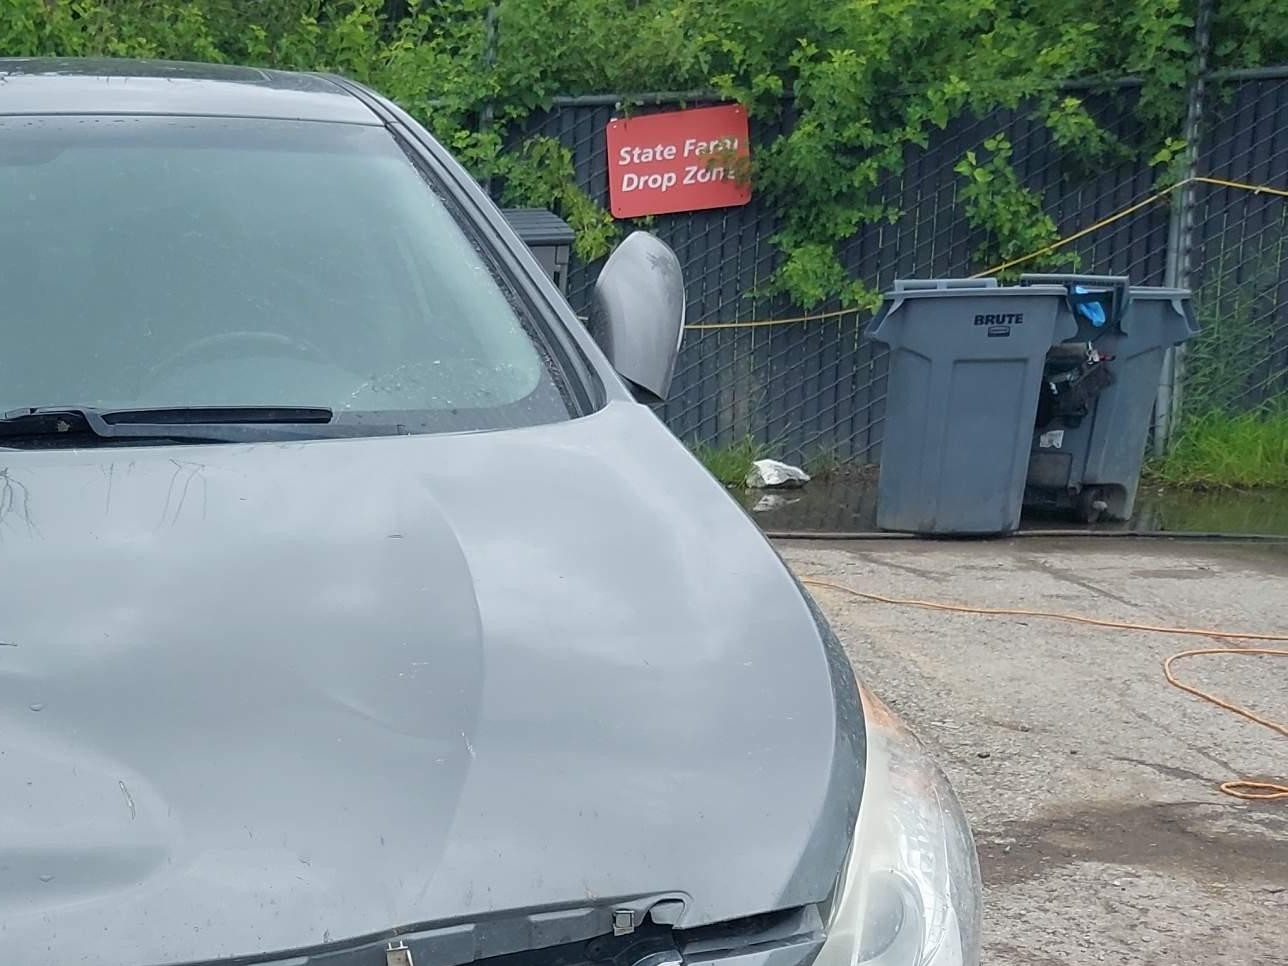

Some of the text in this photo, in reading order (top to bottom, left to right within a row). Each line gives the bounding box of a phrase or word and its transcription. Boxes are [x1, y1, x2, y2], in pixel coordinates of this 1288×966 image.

[618, 143, 677, 165] State
[621, 172, 677, 192] Drop
[974, 313, 1024, 326] BRUTE
